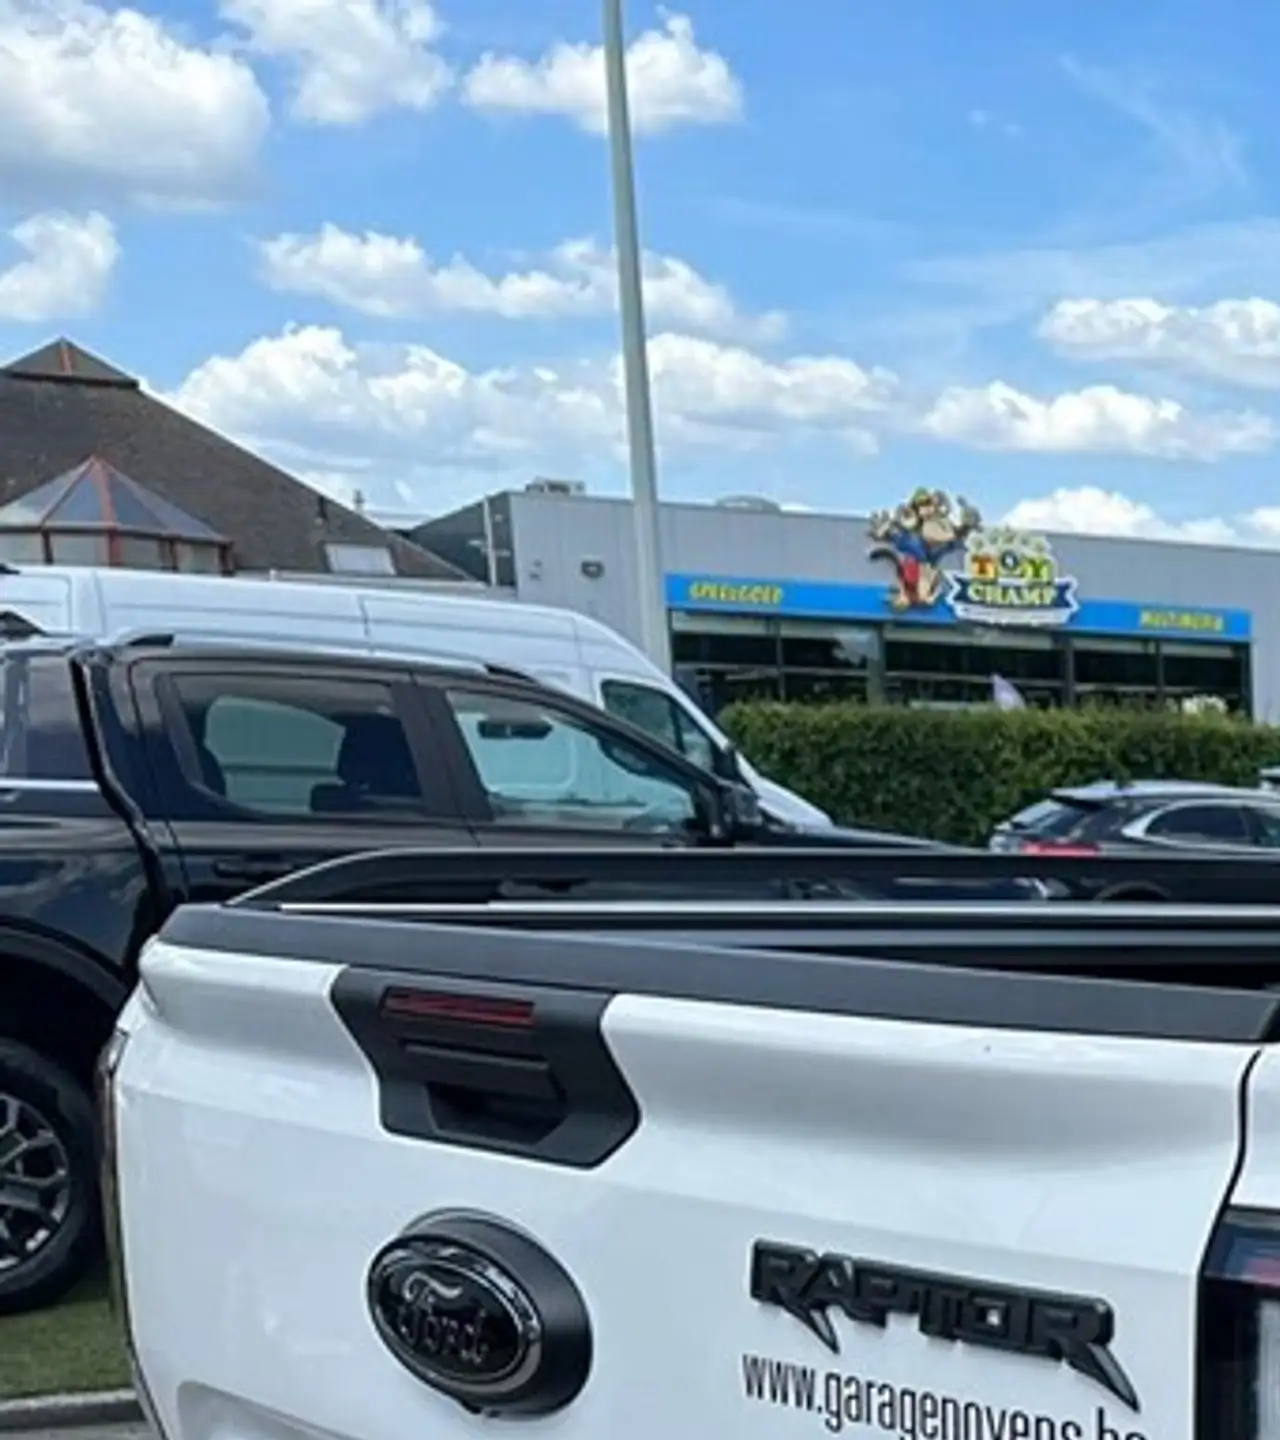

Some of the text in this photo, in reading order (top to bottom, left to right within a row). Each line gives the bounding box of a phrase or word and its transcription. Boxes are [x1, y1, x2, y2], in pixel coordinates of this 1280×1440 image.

[967, 583, 1057, 606] CHAMP
[971, 551, 1050, 582] TOY
[396, 1270, 490, 1365] Ford
[749, 1238, 1140, 1413] RAPTOR
